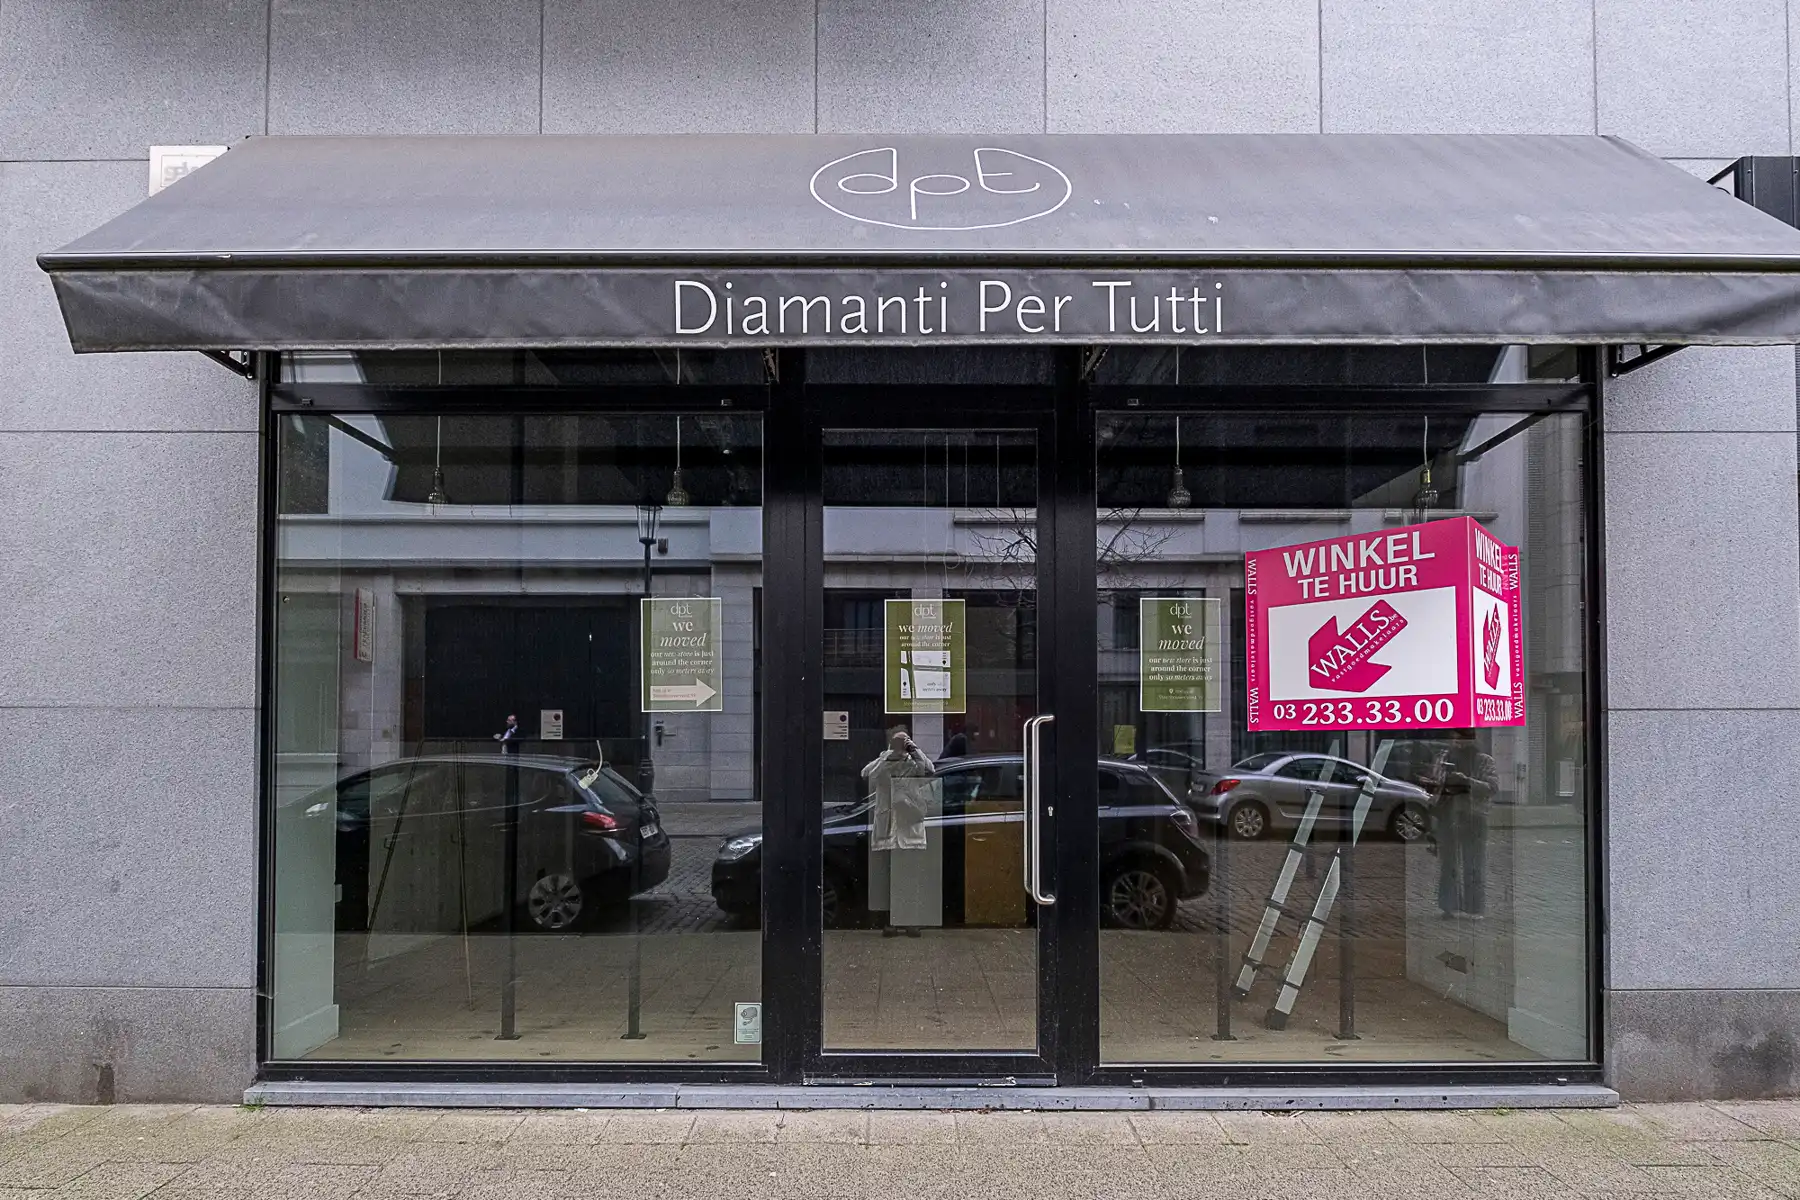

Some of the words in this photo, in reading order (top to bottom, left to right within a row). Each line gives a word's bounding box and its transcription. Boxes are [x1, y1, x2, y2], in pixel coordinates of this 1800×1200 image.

[674, 280, 947, 335] Diamanti
[979, 281, 1072, 332] Per
[1092, 281, 1223, 334] Tutti
[1283, 530, 1436, 578] WINKEL
[1475, 528, 1504, 574] WINKEL
[1247, 559, 1257, 595] WALLS
[1297, 576, 1330, 599] TE
[1339, 564, 1418, 595] HUUR
[1509, 553, 1519, 590] WALLS
[660, 632, 707, 647] moved
[672, 621, 694, 632] we
[898, 624, 915, 632] we
[917, 622, 953, 632] moved
[1159, 636, 1205, 650] moved
[1171, 624, 1193, 635] we
[1311, 609, 1390, 677] WALLS
[1148, 673, 1164, 681] only
[1249, 687, 1259, 724] WALLS
[1273, 704, 1297, 720] 03
[1302, 699, 1454, 725] 233.33.00
[1513, 682, 1524, 719] WALLS
